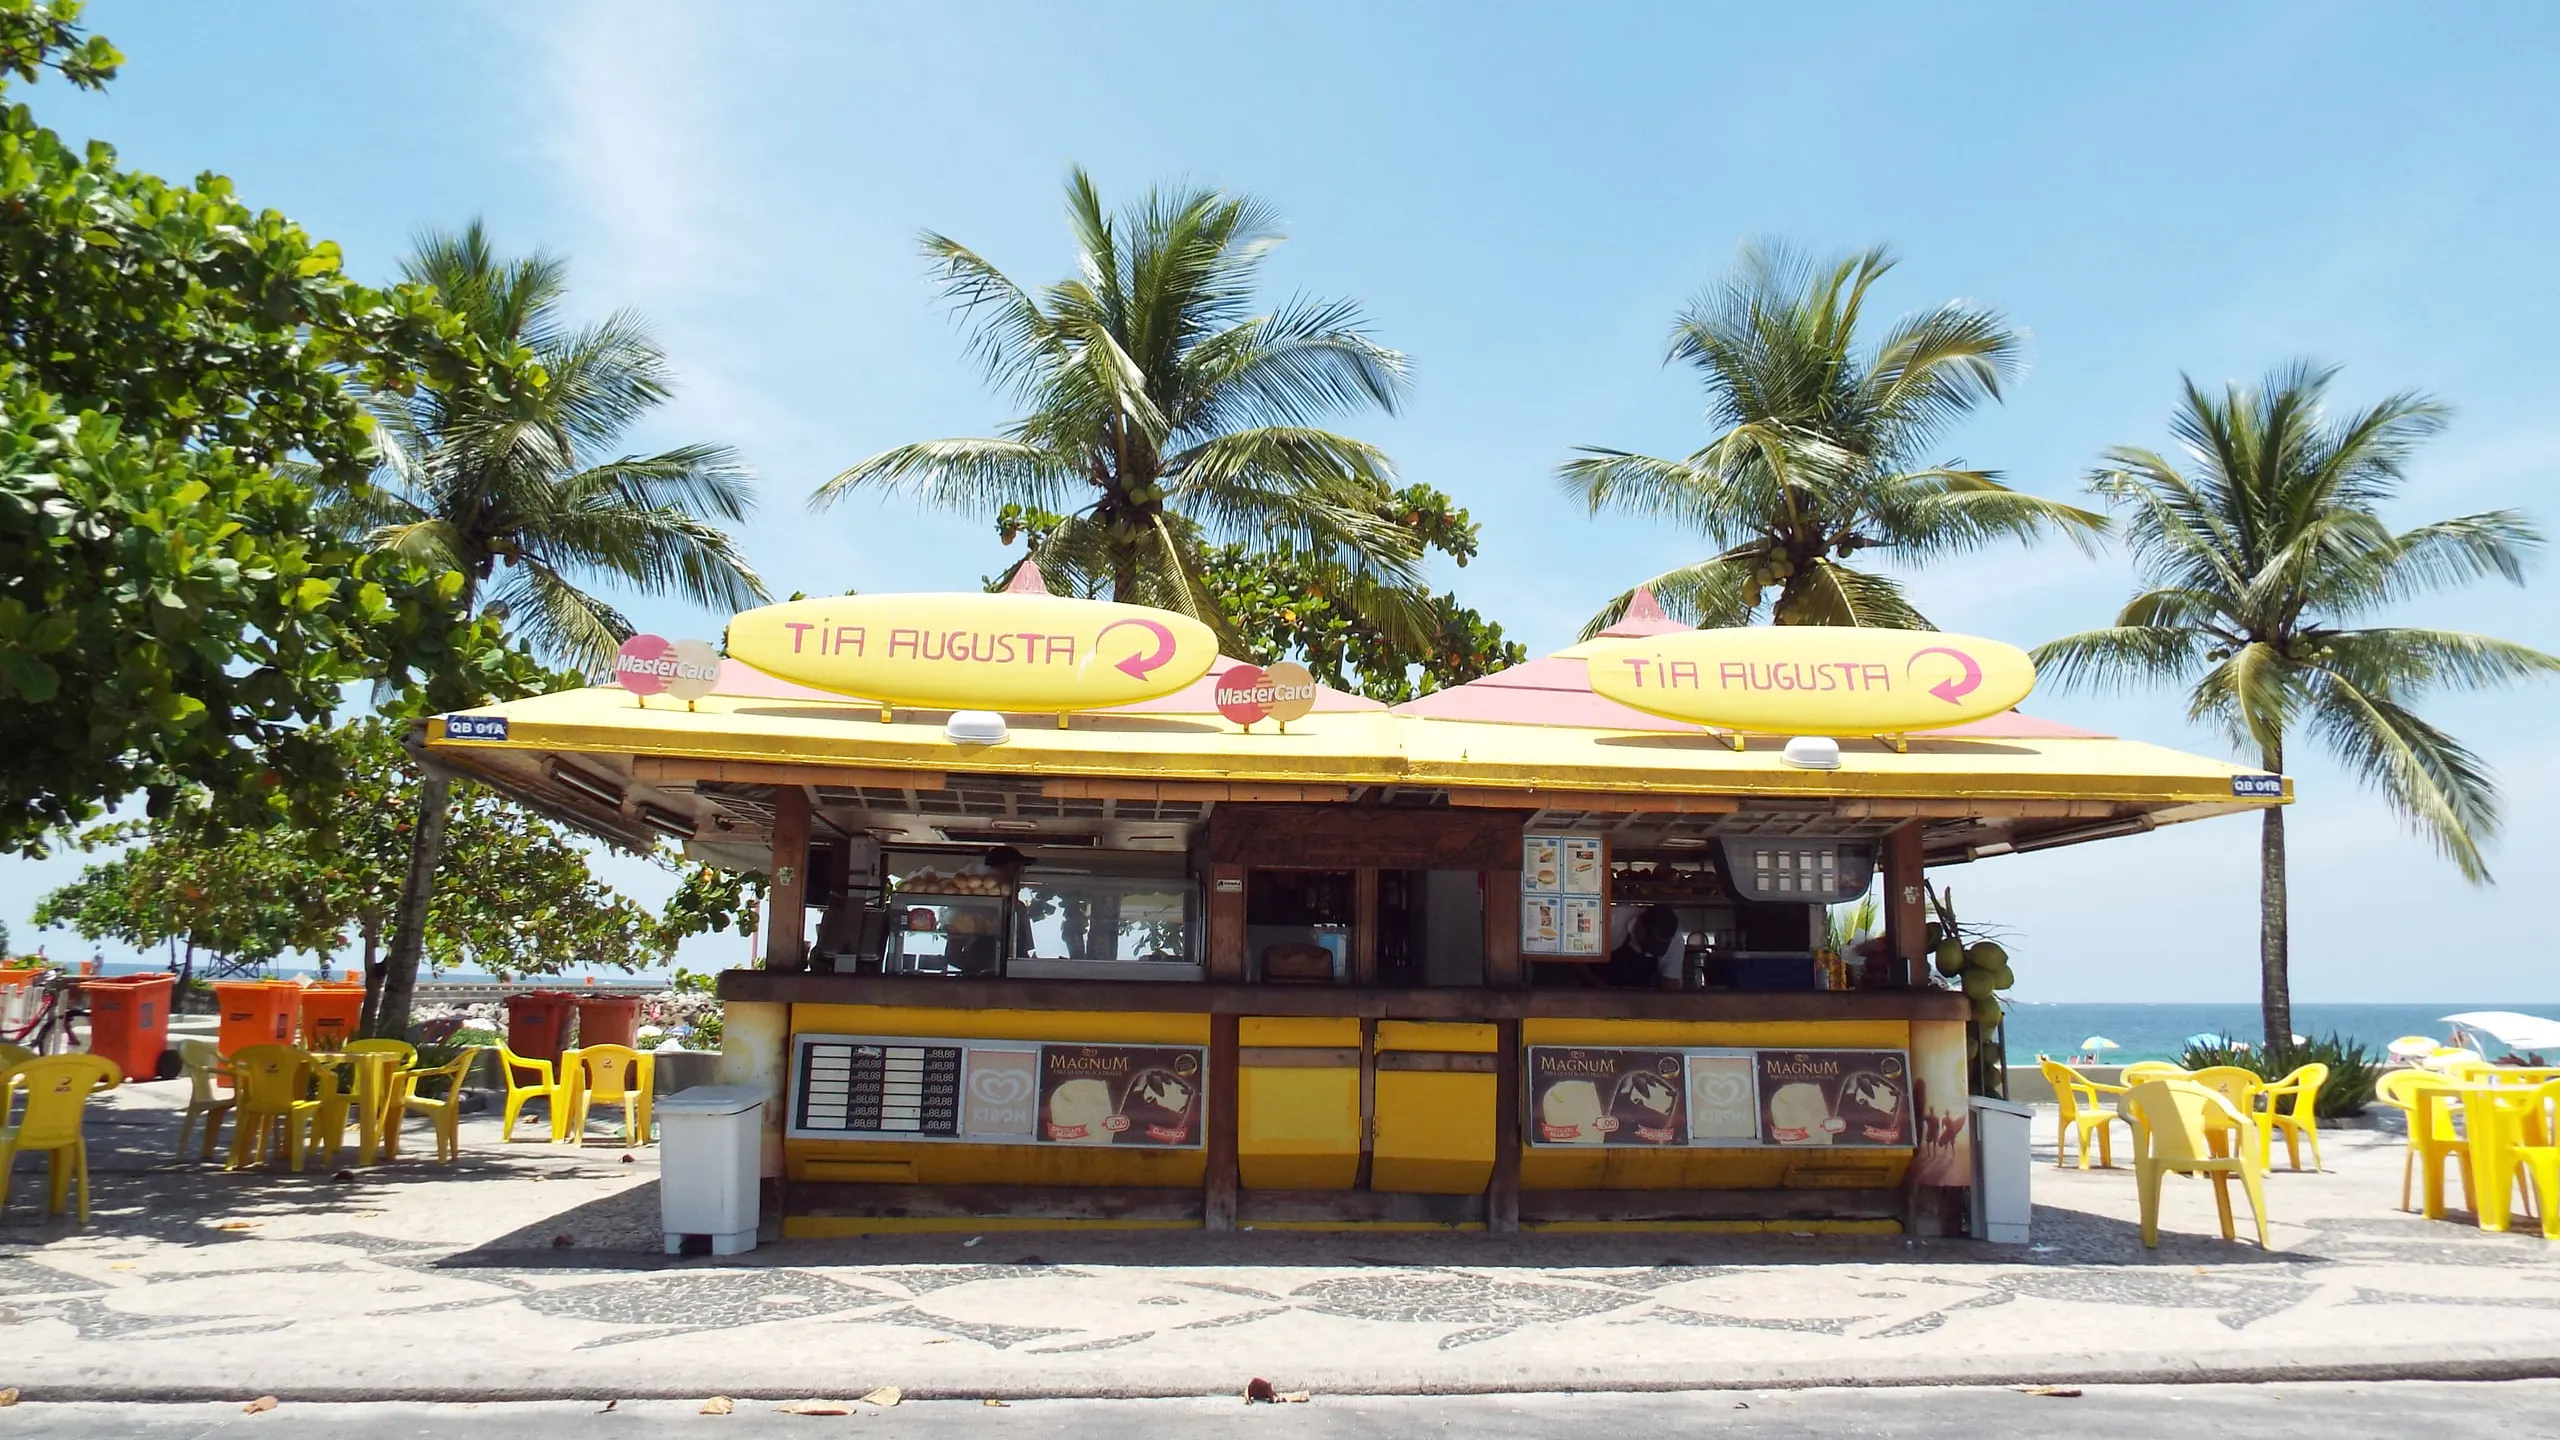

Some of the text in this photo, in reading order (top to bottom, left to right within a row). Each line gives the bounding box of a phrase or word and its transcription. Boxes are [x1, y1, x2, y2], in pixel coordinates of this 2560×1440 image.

[889, 628, 1075, 665] AUGUSTA
[616, 654, 716, 682] MasterCard
[1720, 662, 1890, 691] AUGUSTA
[1217, 682, 1314, 706] MasterCard
[450, 722, 504, 735] QB 01A
[2234, 780, 2280, 792] QB 01B
[1050, 1054, 1129, 1071] MAGNUM
[1541, 1056, 1616, 1073] MAGNUM
[1767, 1060, 1840, 1075] MAGNUM
